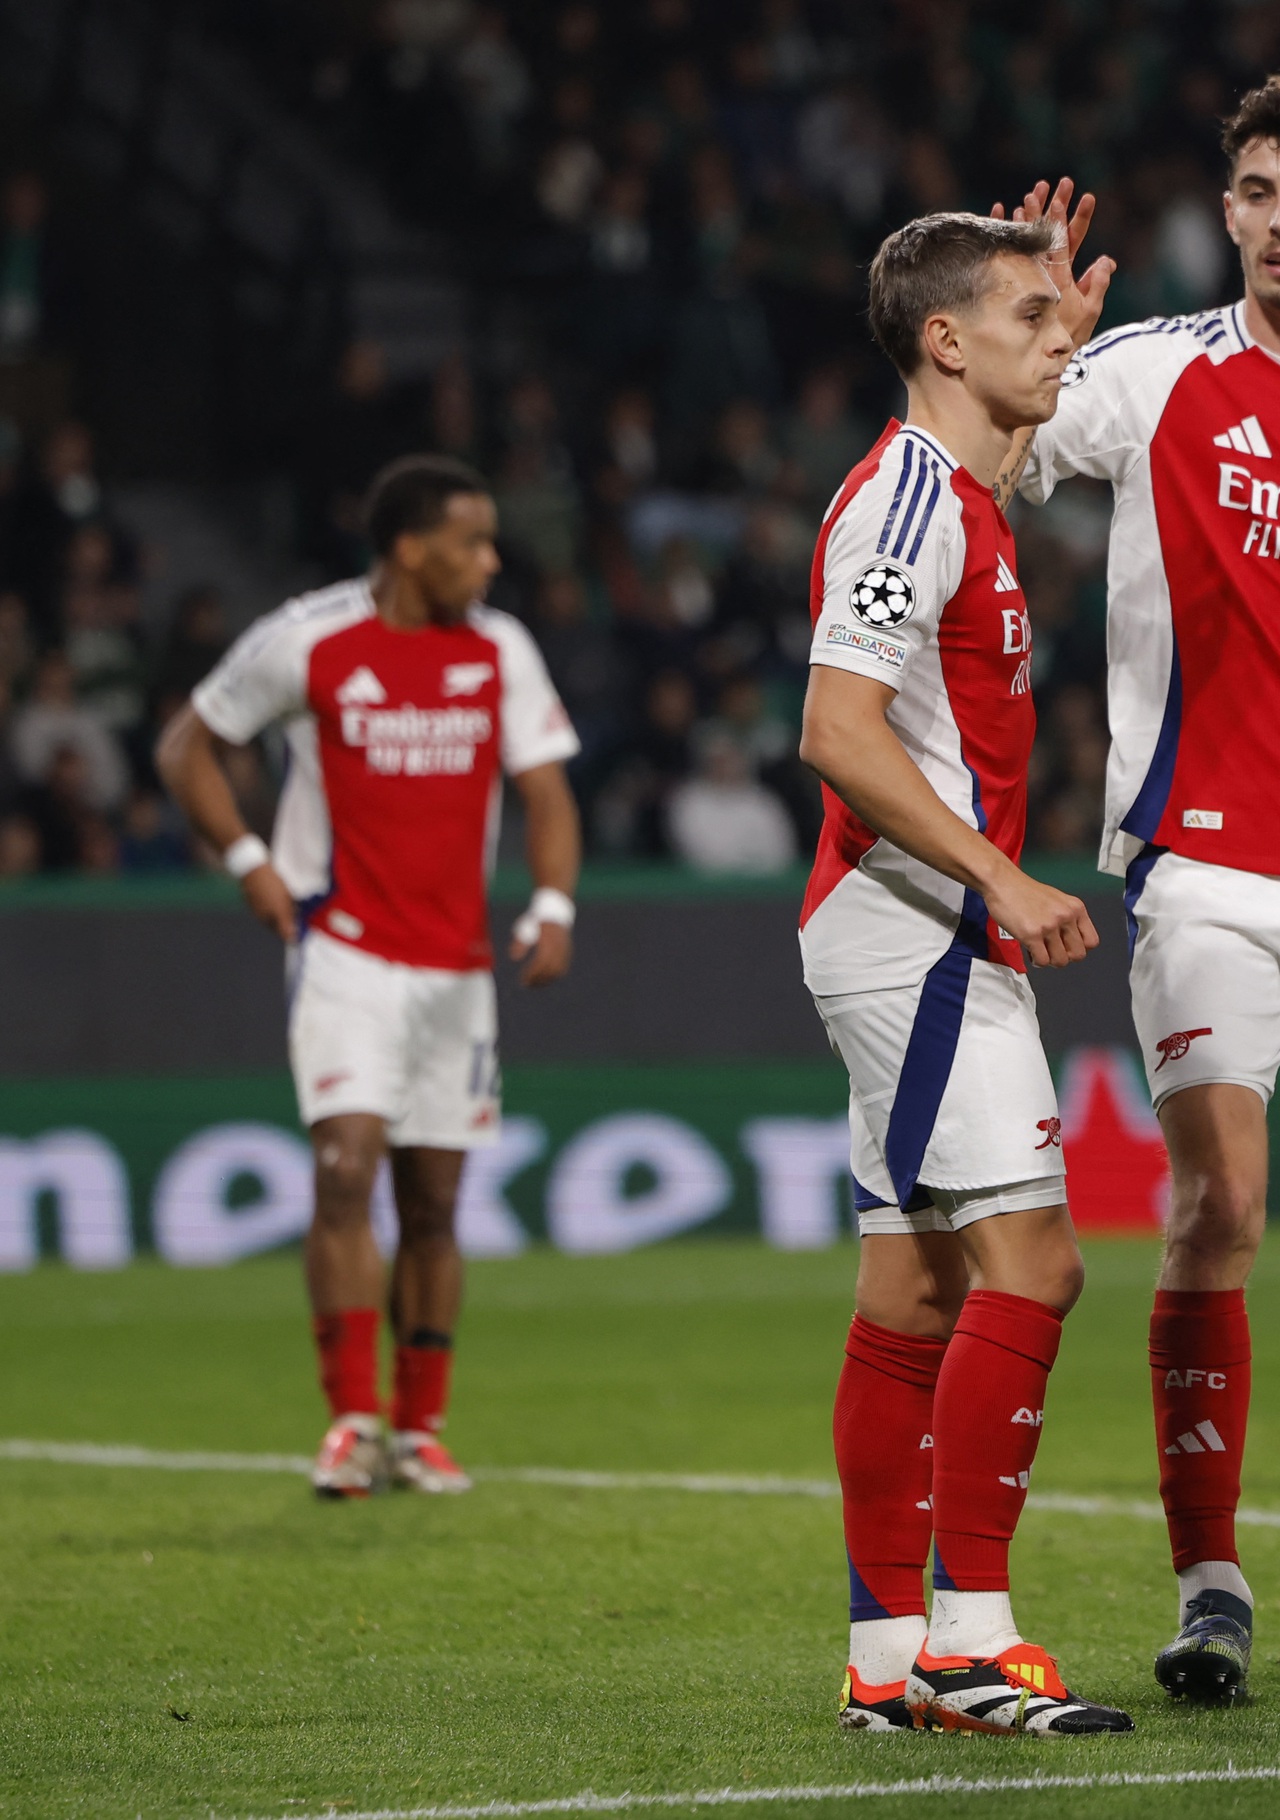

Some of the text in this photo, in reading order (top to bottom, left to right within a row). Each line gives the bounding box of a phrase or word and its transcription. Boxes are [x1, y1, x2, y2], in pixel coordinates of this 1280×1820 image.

[827, 630, 906, 661] FOUNDATION
[1164, 1368, 1227, 1390] AFC
[1011, 1407, 1044, 1427] AF
